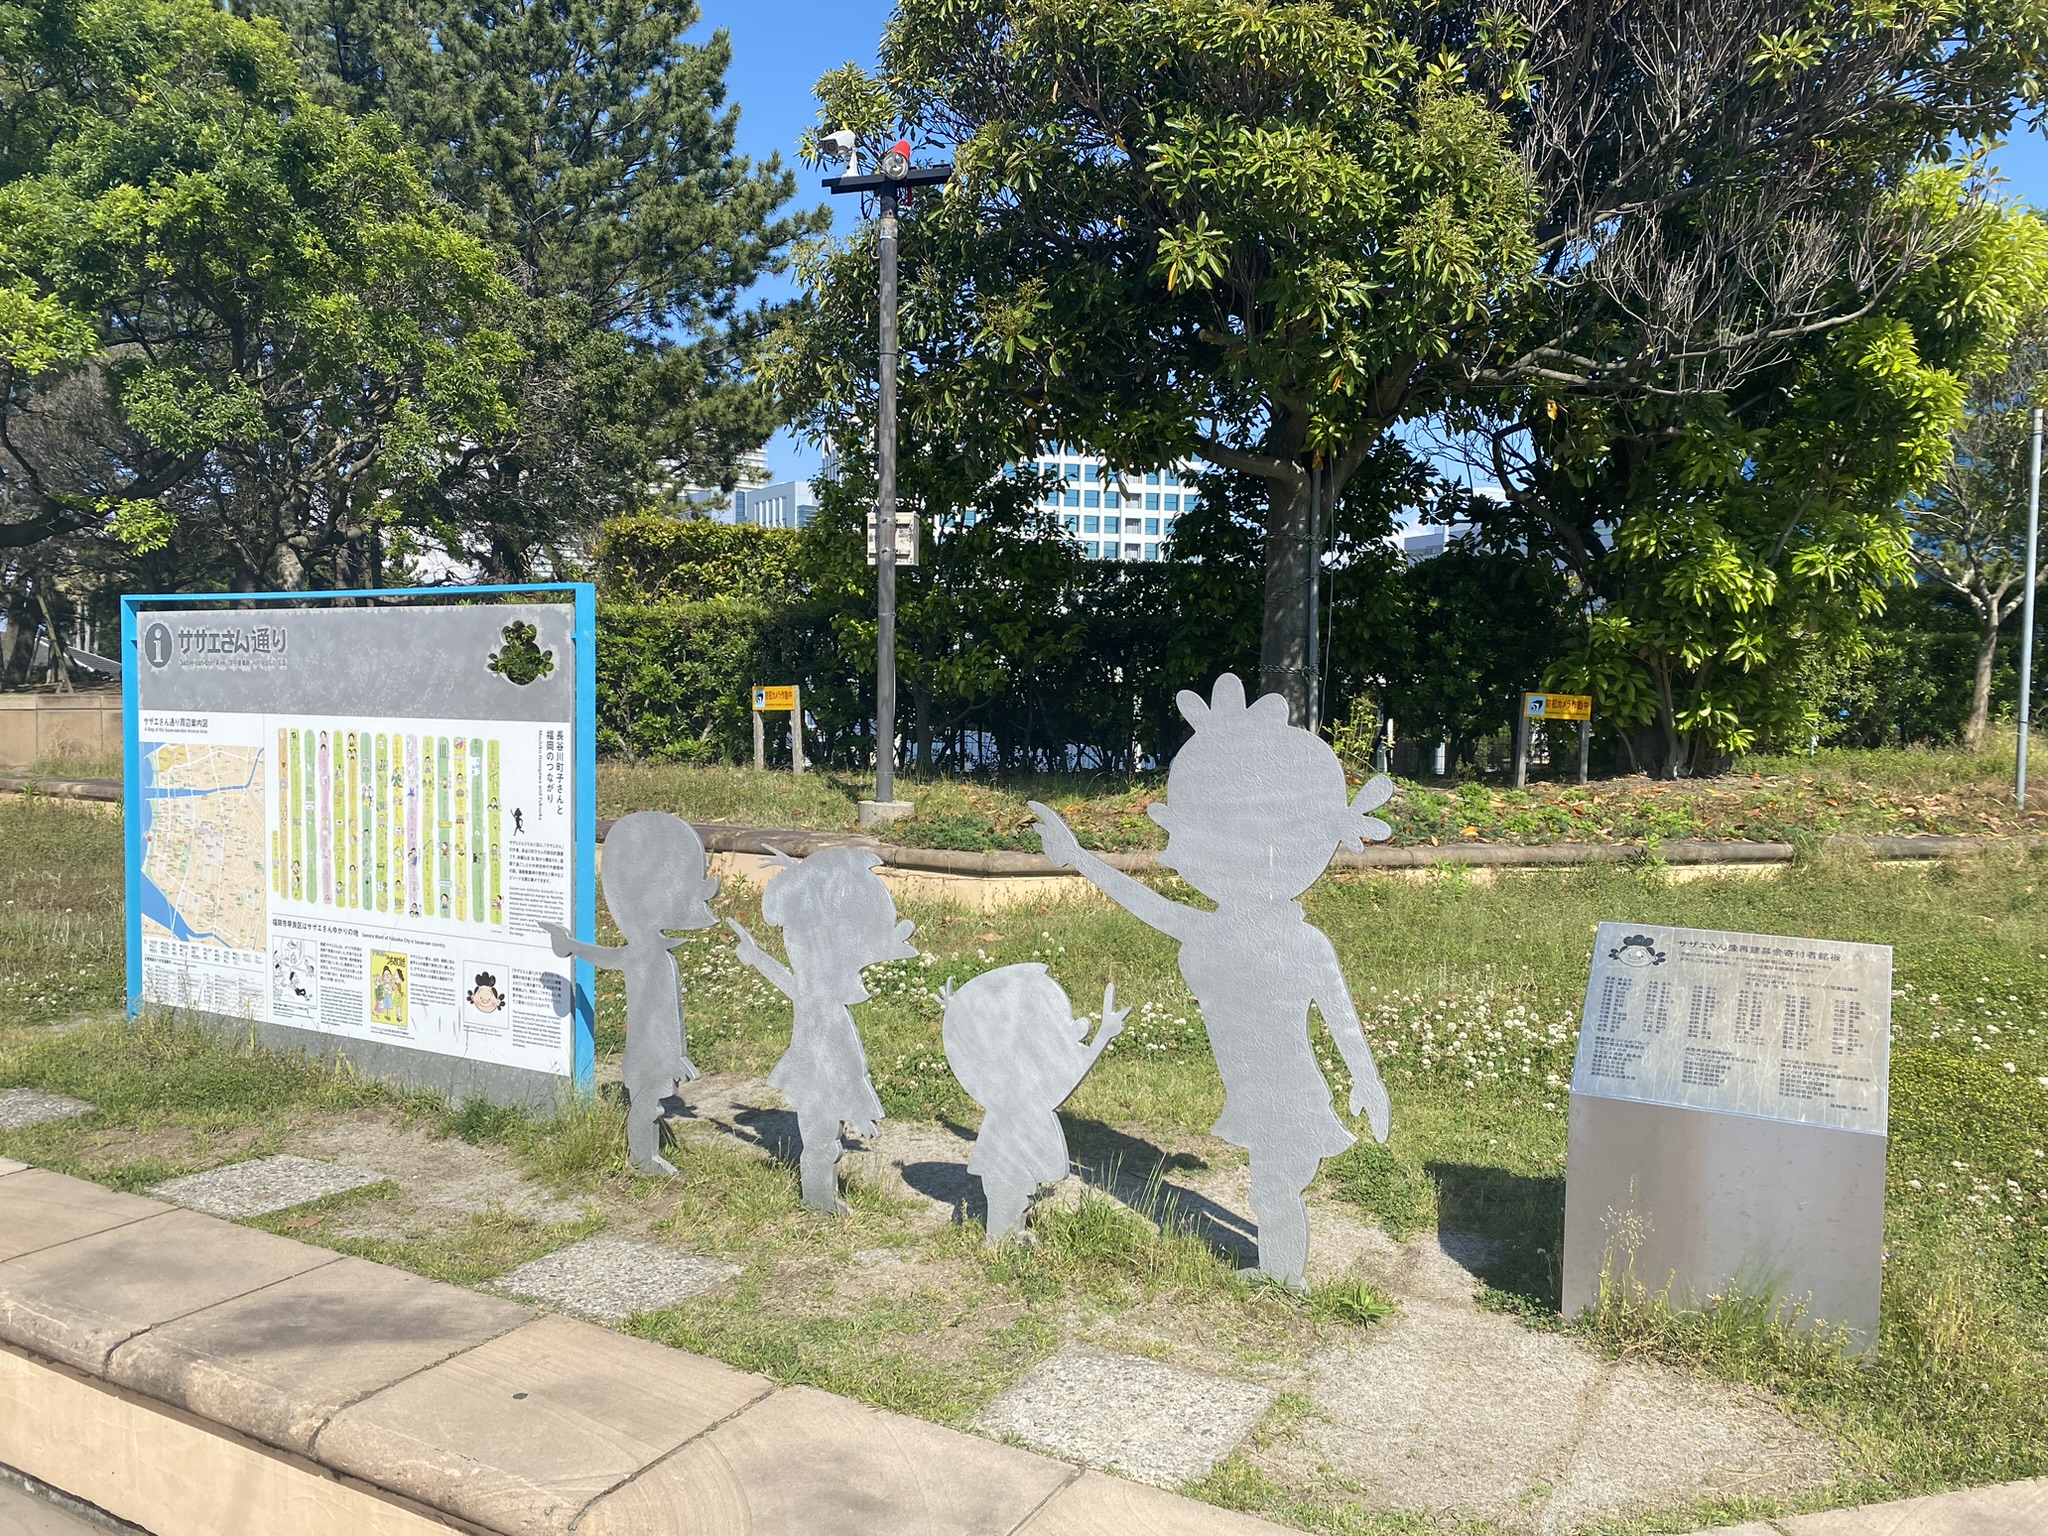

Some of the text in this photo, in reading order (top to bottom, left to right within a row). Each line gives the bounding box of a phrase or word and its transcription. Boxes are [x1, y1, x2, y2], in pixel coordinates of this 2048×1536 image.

[178, 627, 287, 655] サザエさん通り
[1546, 698, 1590, 710] 防犯カメラ作動中
[143, 718, 209, 728] サザエさん通り周辺案内図
[546, 730, 554, 804] 福岡のつながり
[556, 730, 564, 815] 長谷川町子さんと
[272, 918, 359, 937] 福岡市早良区はサザエさんゆかりの地
[1678, 940, 1841, 962] サザエさん像再建募金寄付者銘板
